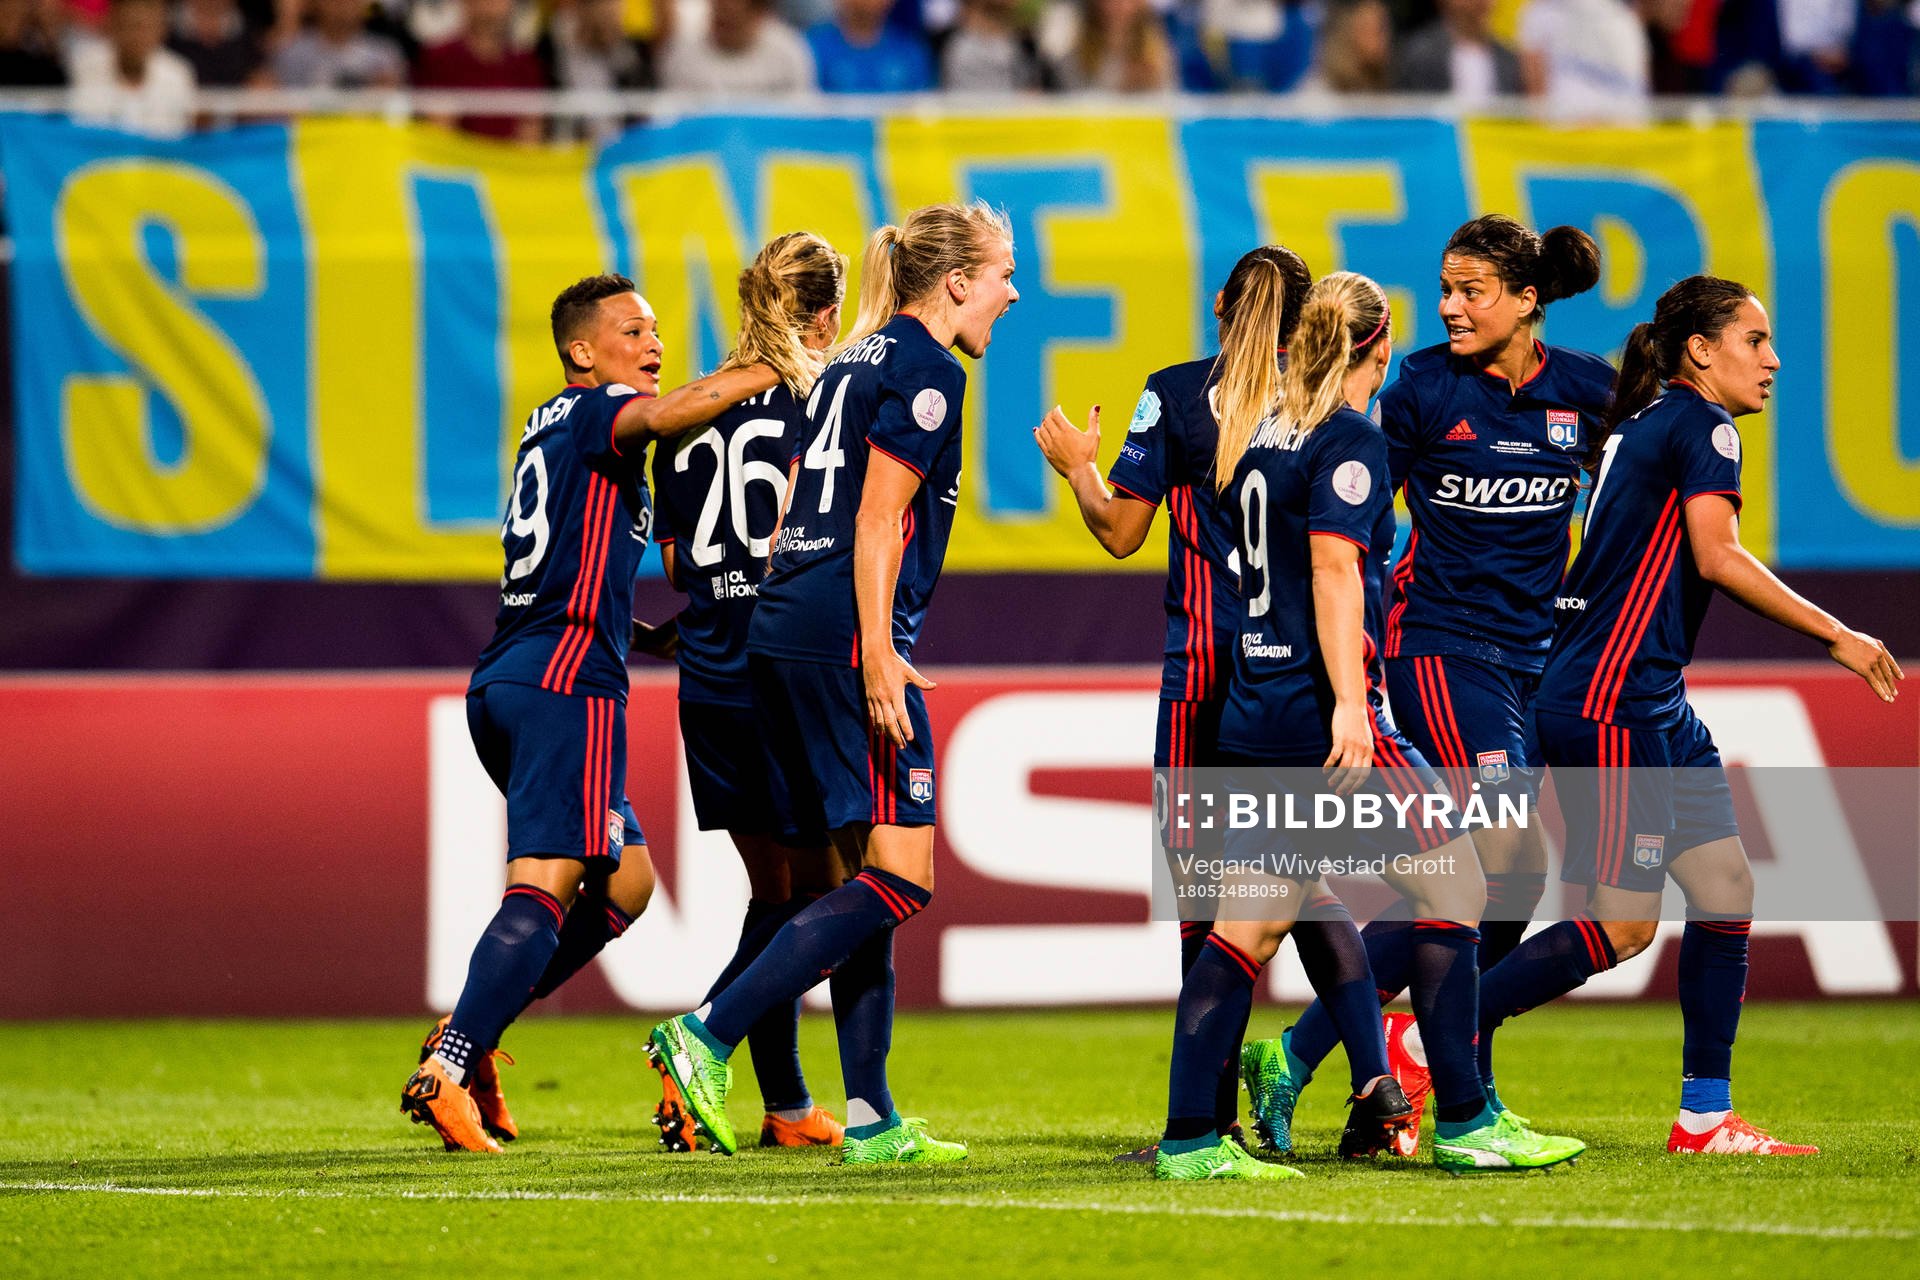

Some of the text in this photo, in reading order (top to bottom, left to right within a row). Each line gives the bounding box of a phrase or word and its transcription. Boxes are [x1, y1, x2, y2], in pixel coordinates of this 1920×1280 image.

[1247, 415, 1311, 451] OMMER
[1551, 425, 1575, 442] OL
[675, 418, 790, 567] 26
[1436, 474, 1570, 504] SWORD
[501, 446, 549, 588] 9
[1241, 469, 1270, 617] 9
[729, 570, 747, 583] OL
[913, 783, 930, 797] OL
